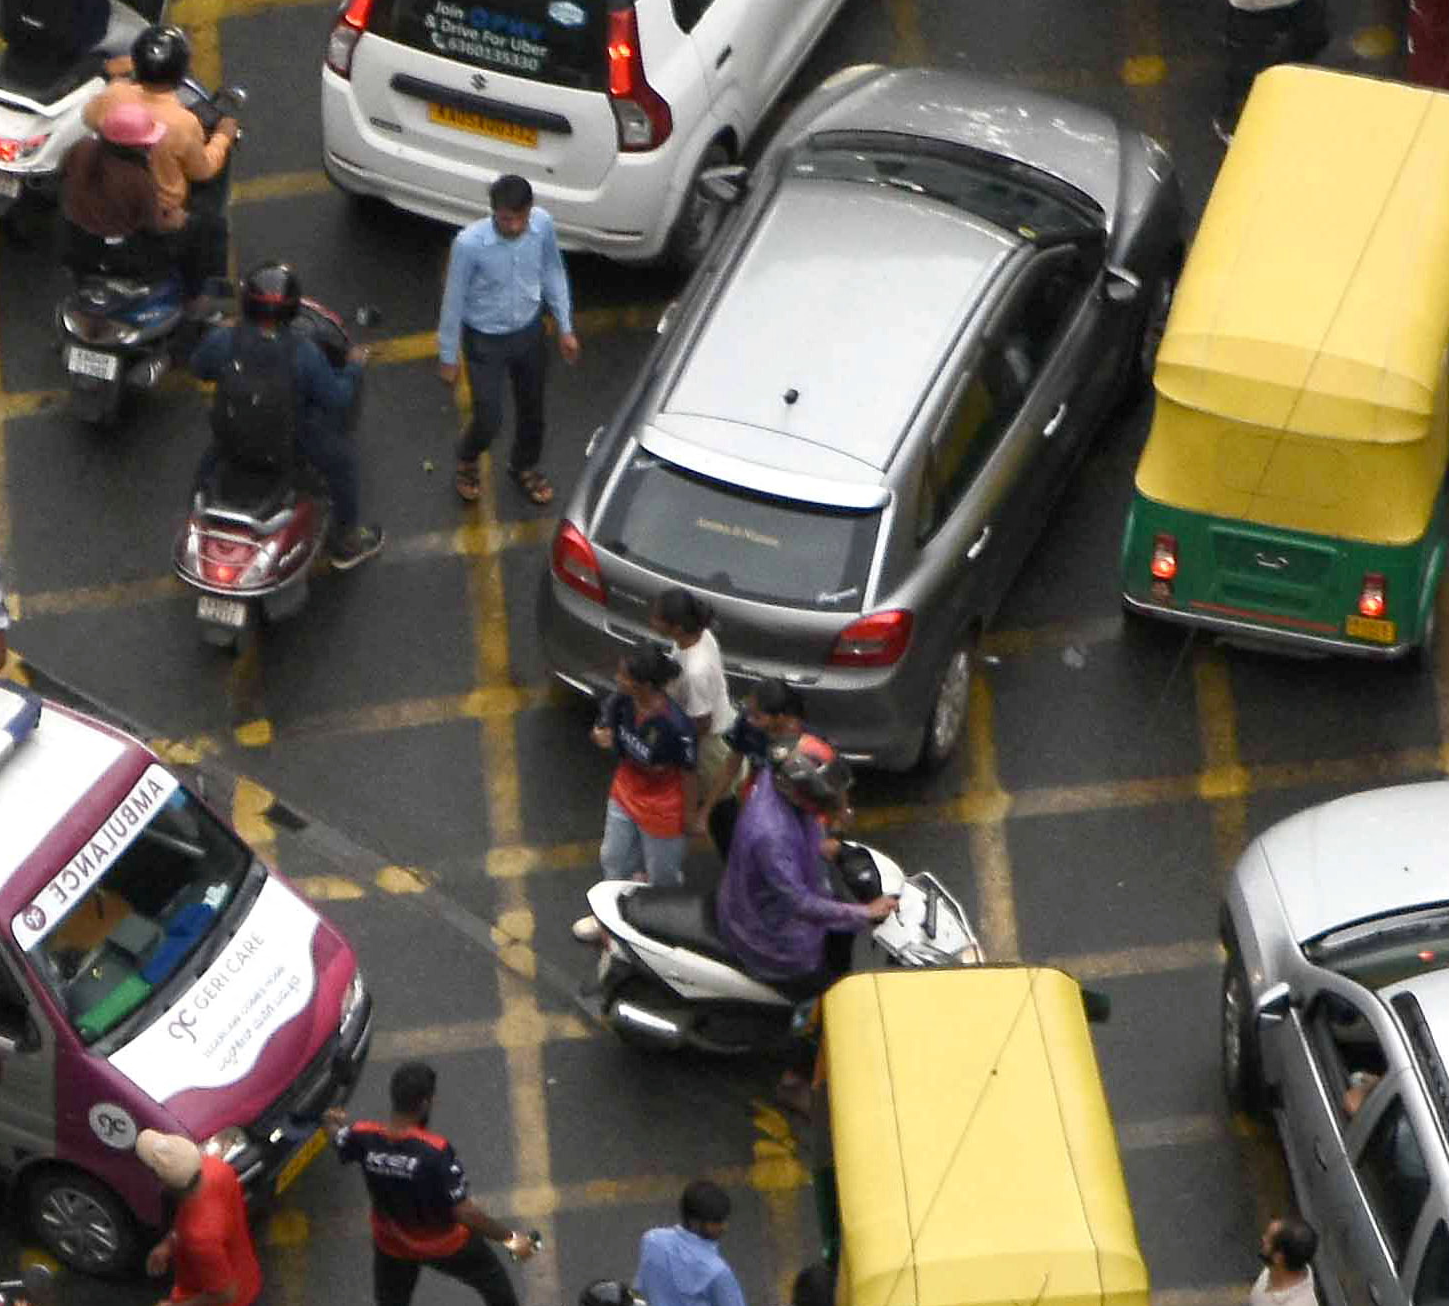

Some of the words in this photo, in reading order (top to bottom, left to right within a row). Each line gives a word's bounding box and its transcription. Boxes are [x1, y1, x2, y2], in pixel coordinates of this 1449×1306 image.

[425, 13, 436, 28] &
[441, 18, 478, 40] Drive
[482, 30, 506, 47] For
[510, 37, 548, 56] Uber
[194, 972, 230, 1010] GERI
[226, 934, 265, 974] CARE
